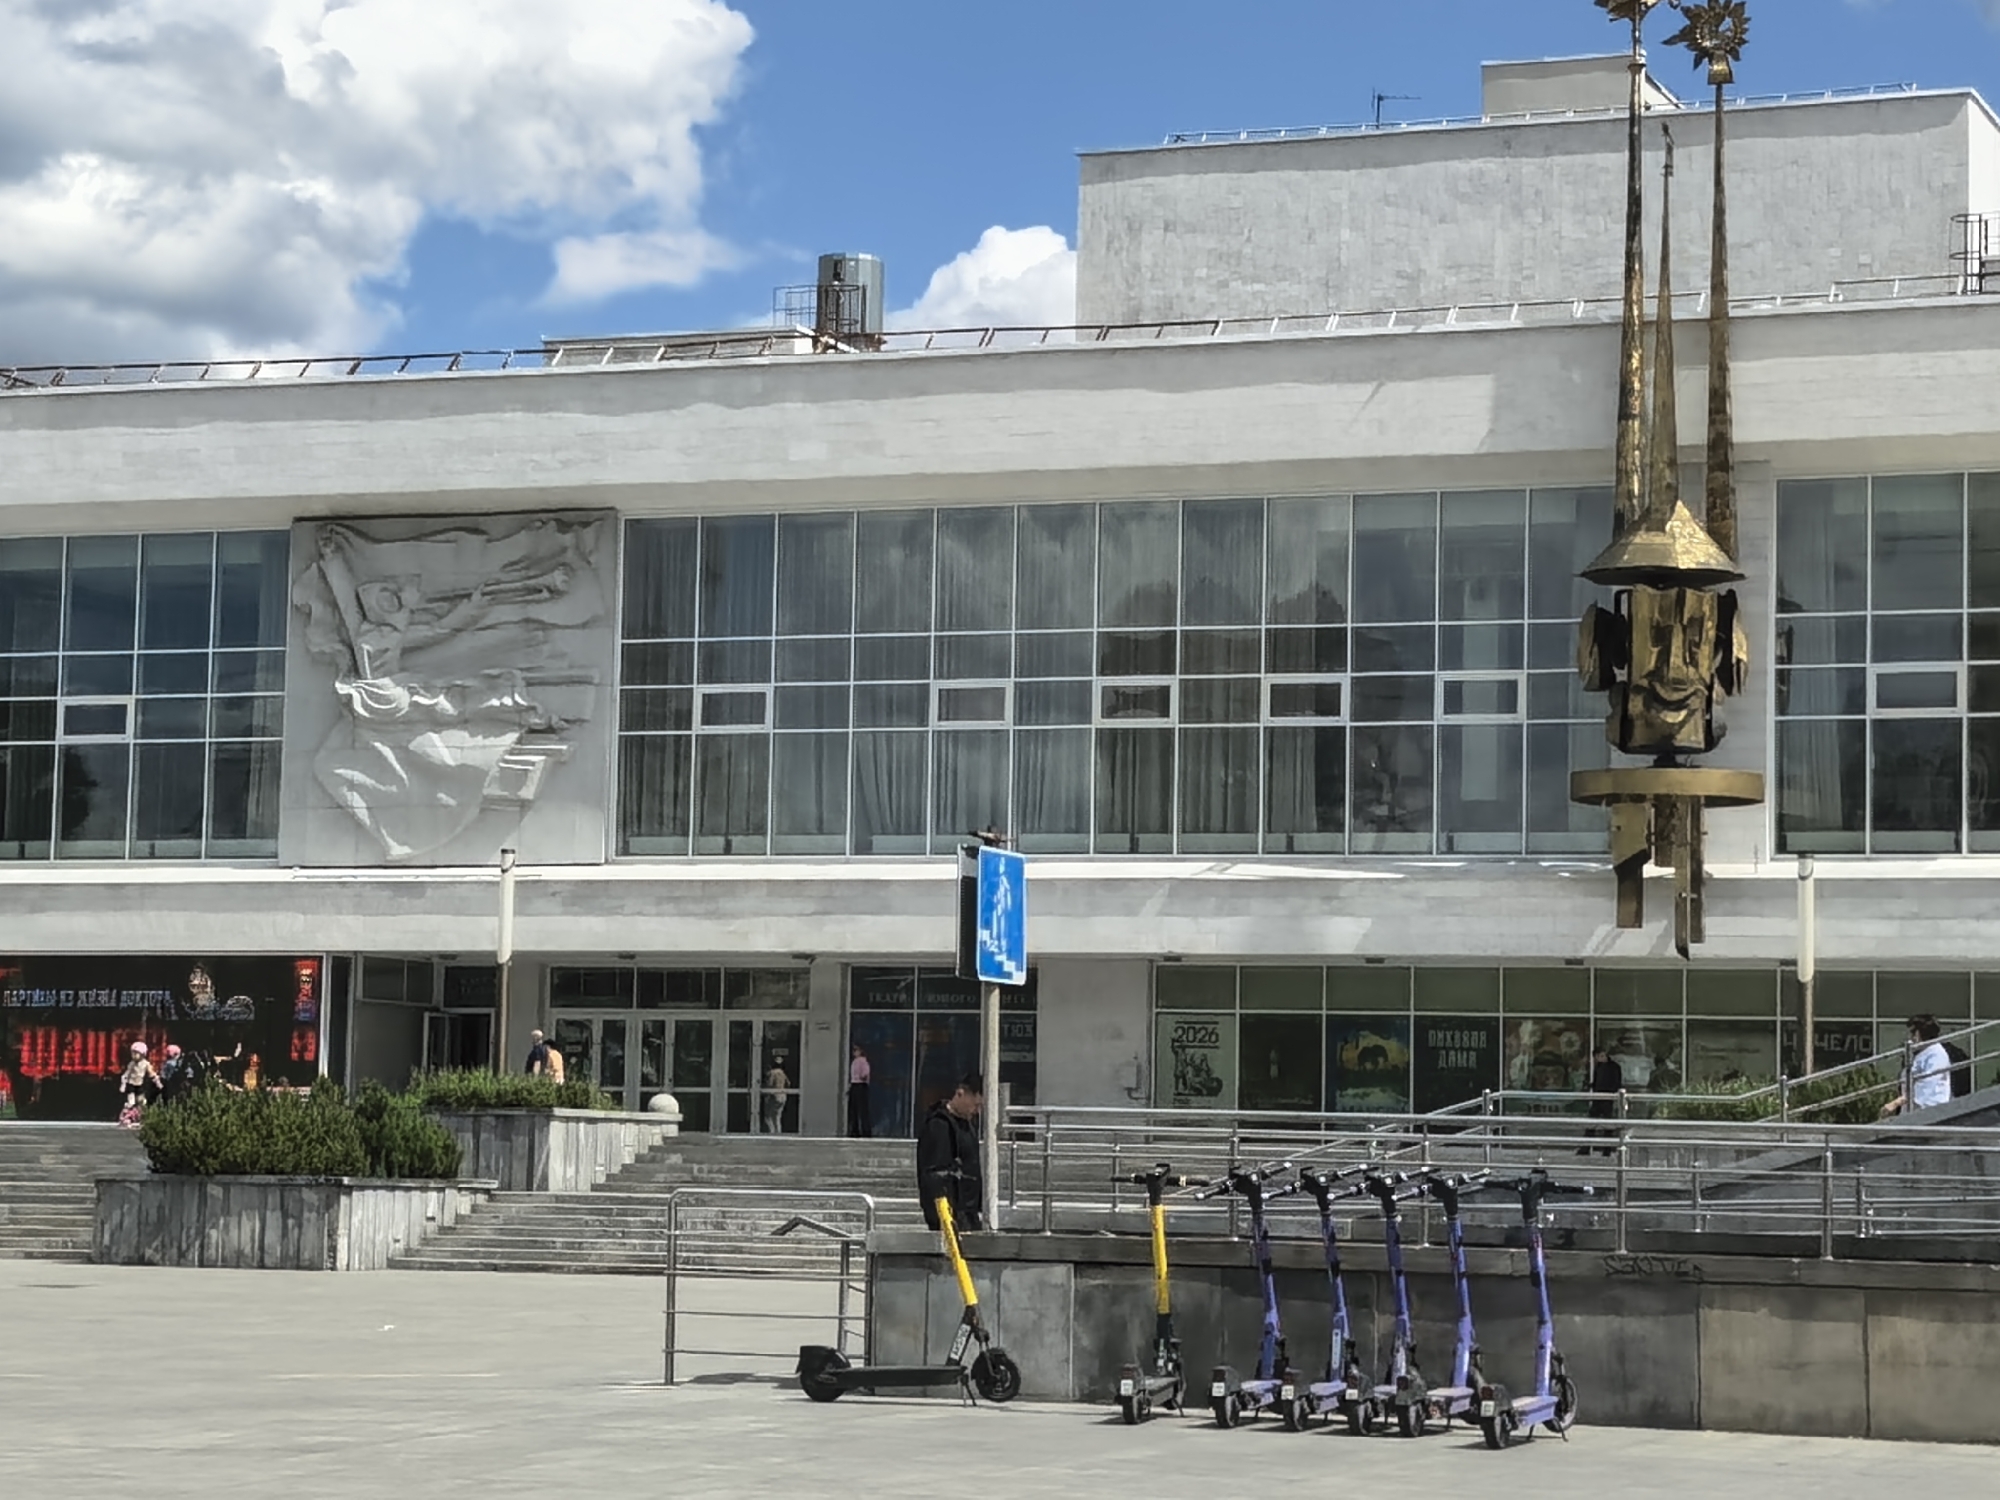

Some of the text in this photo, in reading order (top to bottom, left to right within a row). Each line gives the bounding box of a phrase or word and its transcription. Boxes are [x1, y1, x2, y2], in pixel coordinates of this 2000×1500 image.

[1174, 1026, 1220, 1044] 2026
[1783, 1032, 1872, 1054] ЧЧЕЛО
[1437, 1050, 1477, 1069] ДАМА
